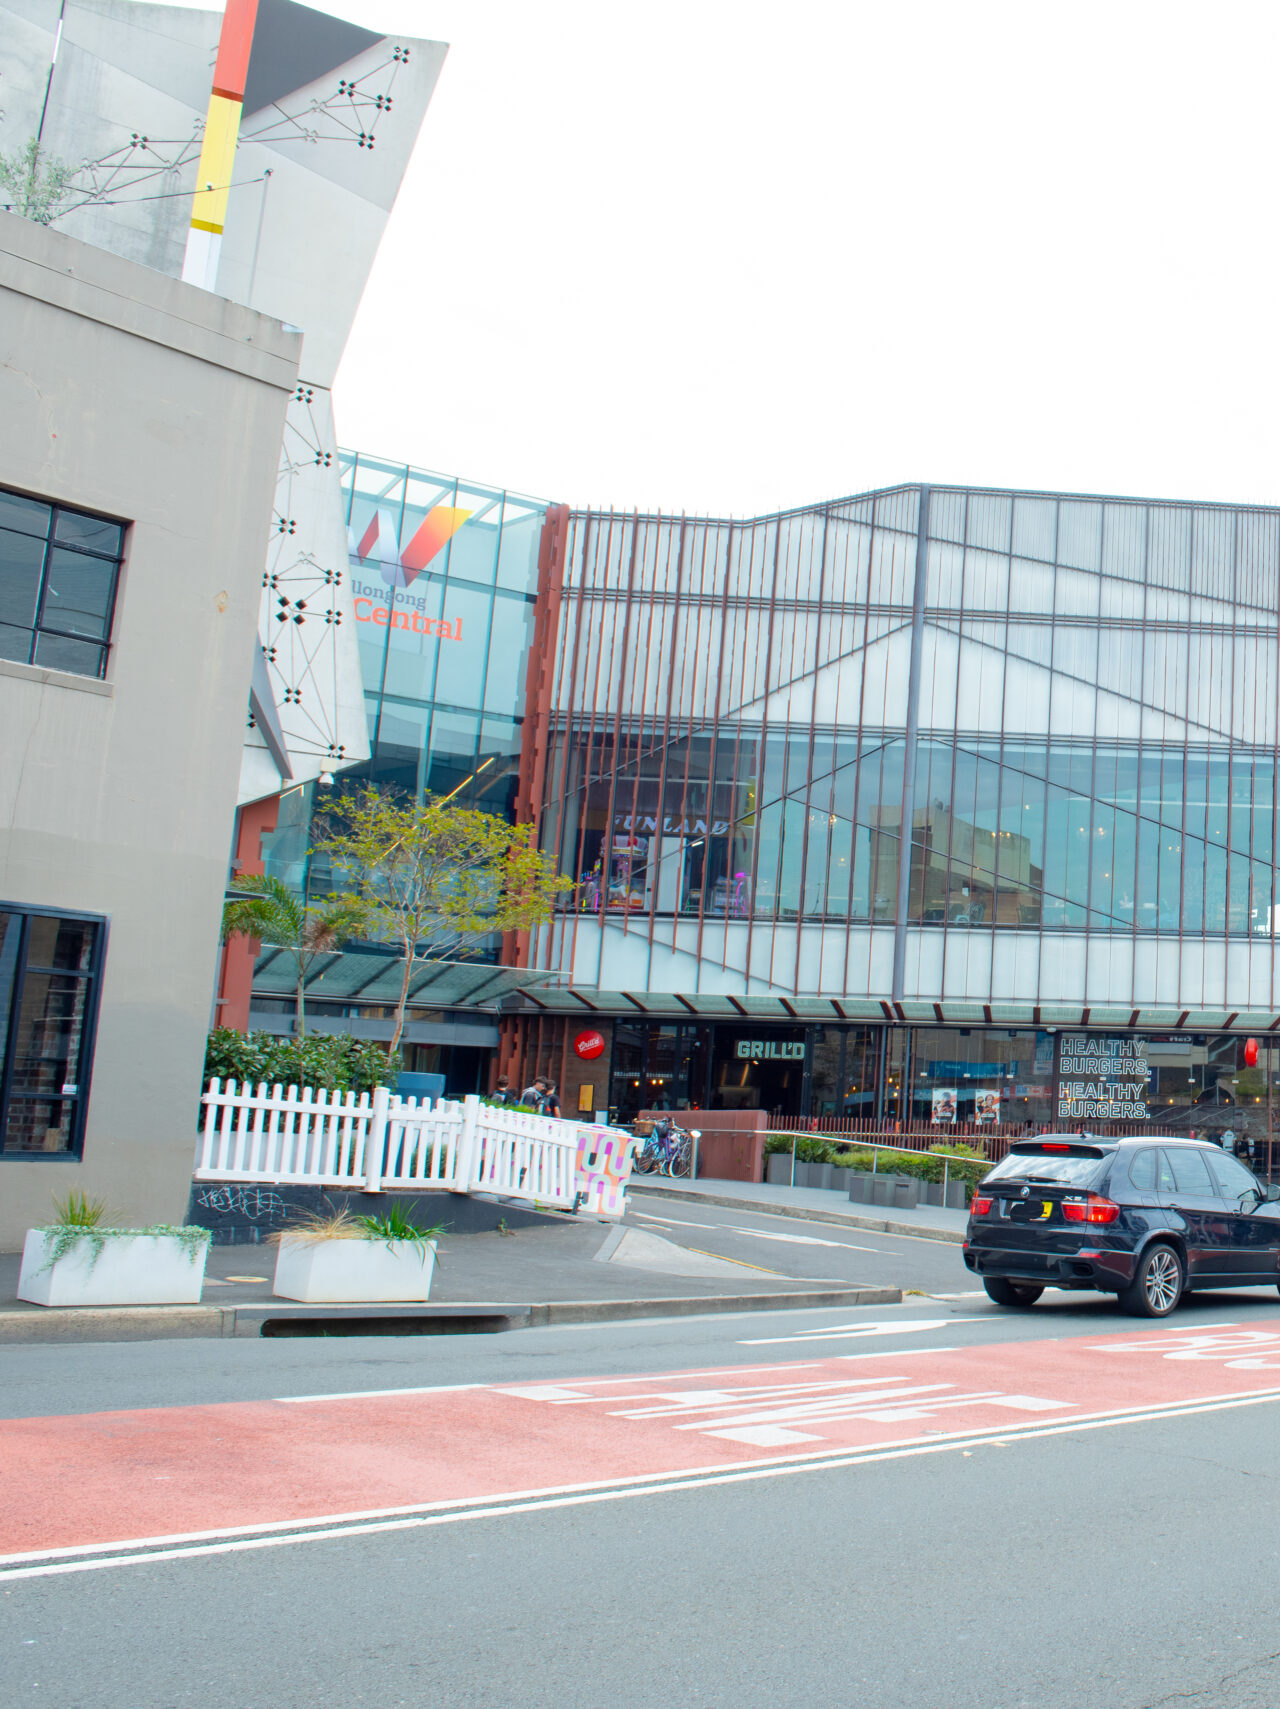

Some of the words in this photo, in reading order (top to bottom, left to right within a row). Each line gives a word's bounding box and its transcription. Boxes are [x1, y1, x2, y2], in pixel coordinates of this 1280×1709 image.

[351, 579, 427, 611] llongong
[353, 597, 463, 641] Central
[613, 814, 730, 835] FUNLAND
[737, 1040, 806, 1060] GRILL'D
[1060, 1038, 1145, 1057] HEALTHY
[1060, 1057, 1152, 1075] BURGERS.
[1059, 1081, 1144, 1099] HEALTHY
[1058, 1101, 1151, 1119] BURGERS.
[489, 1363, 1080, 1447] LANE
